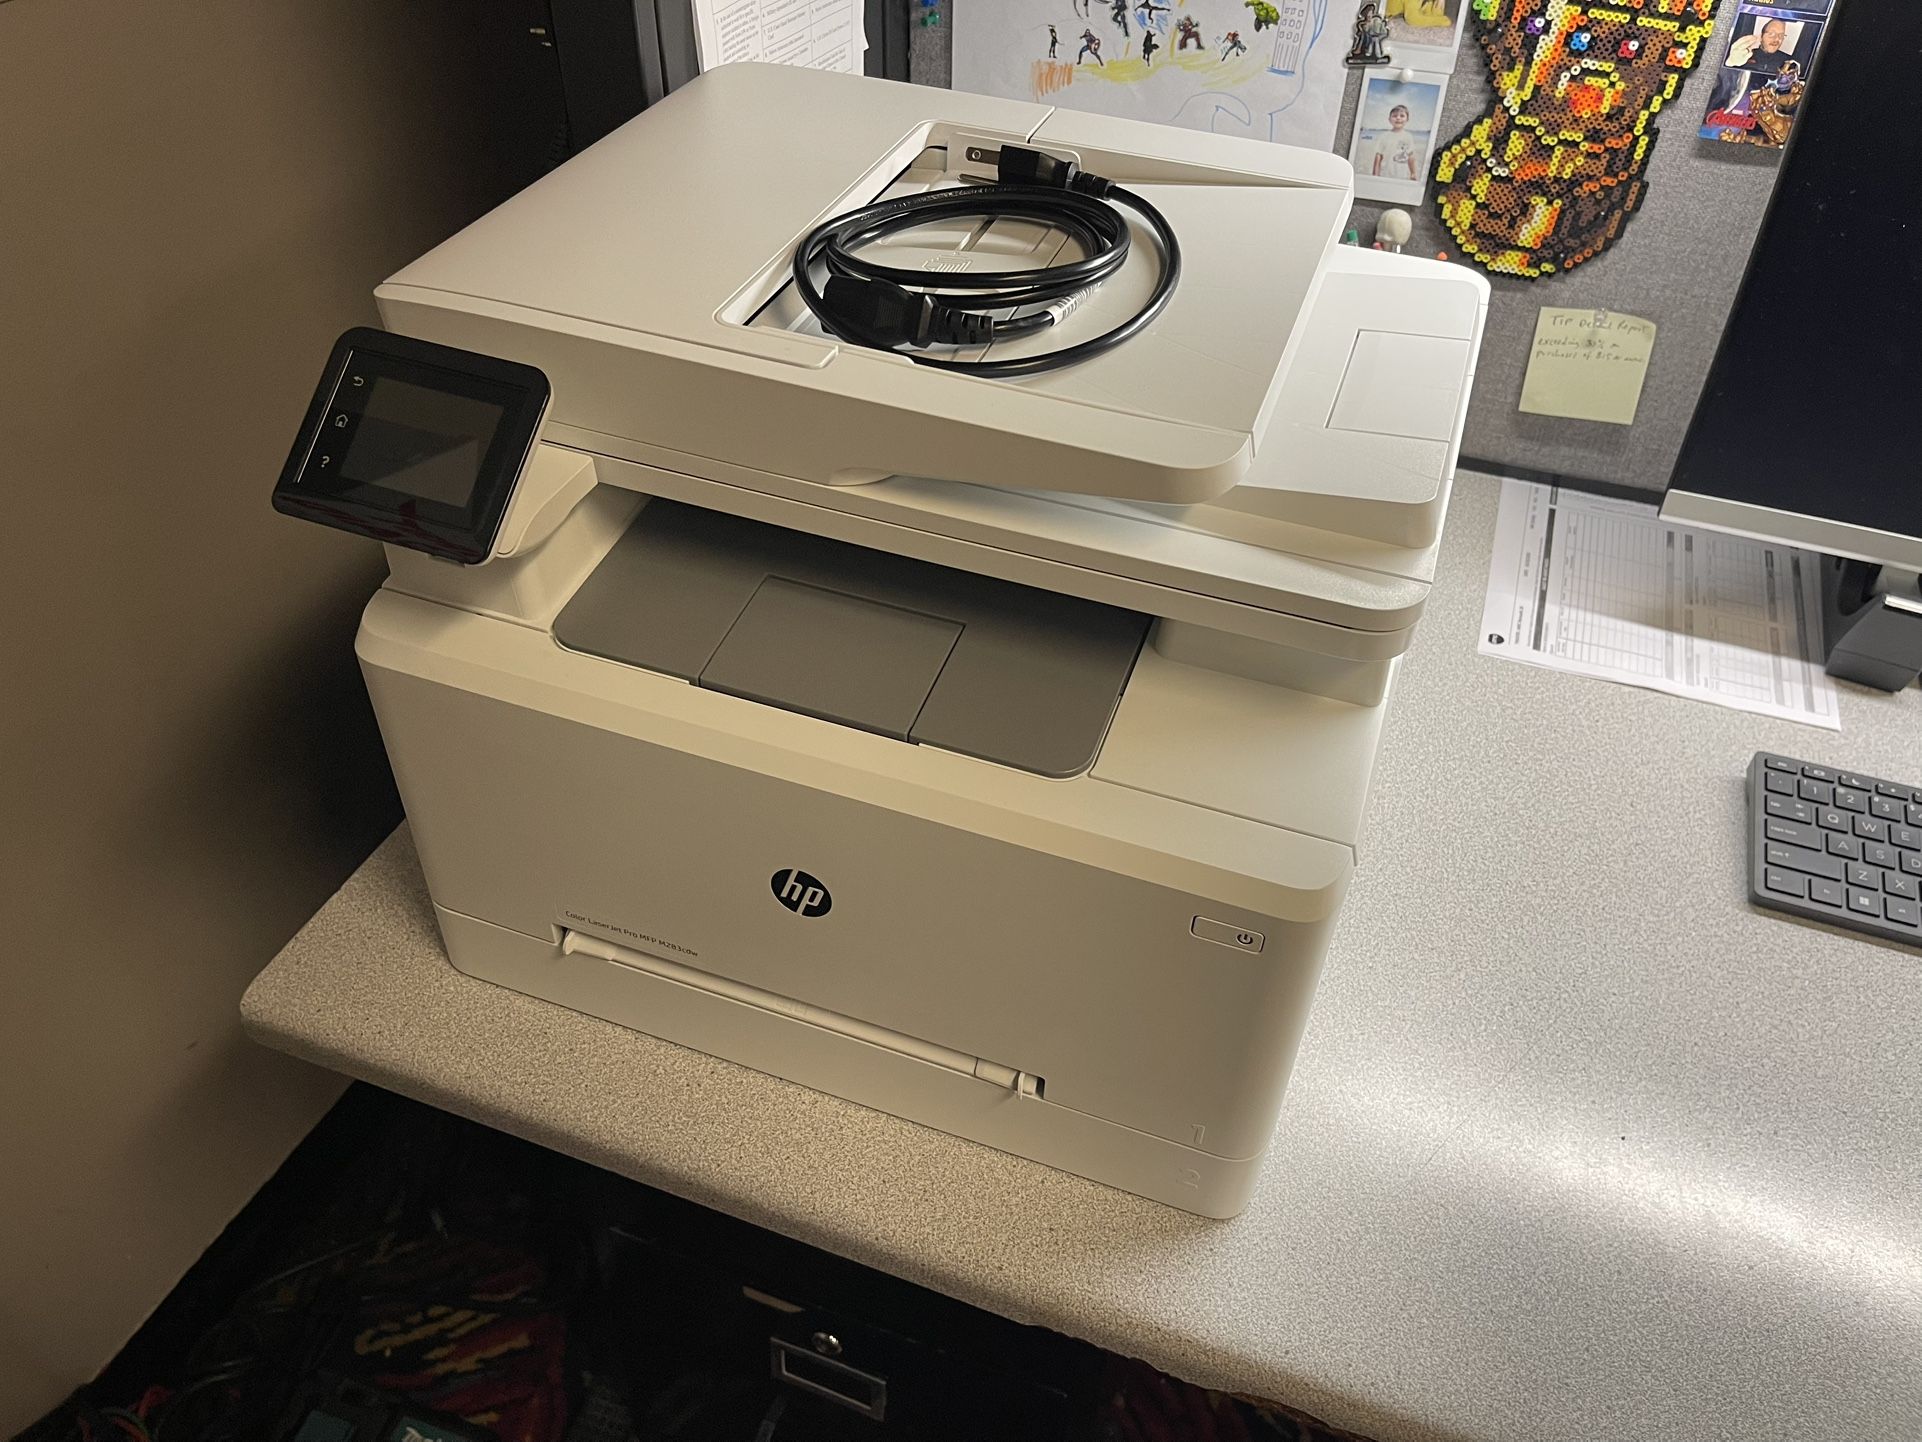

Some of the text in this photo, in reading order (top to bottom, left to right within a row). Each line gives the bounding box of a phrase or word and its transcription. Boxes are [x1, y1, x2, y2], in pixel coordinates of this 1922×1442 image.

[1846, 795, 1855, 804] 2
[1882, 803, 1890, 812] 3
[1827, 814, 1839, 824] Q
[1862, 821, 1877, 833] W
[1901, 831, 1910, 841] E
[1838, 841, 1849, 850] A
[1876, 849, 1885, 859] S
[1911, 858, 1921, 868] D
[1858, 870, 1868, 880] Z
[1895, 879, 1905, 890] X
[778, 868, 827, 916] hp
[565, 910, 586, 922] Color
[624, 929, 638, 938] Pro
[639, 934, 657, 943] MFP
